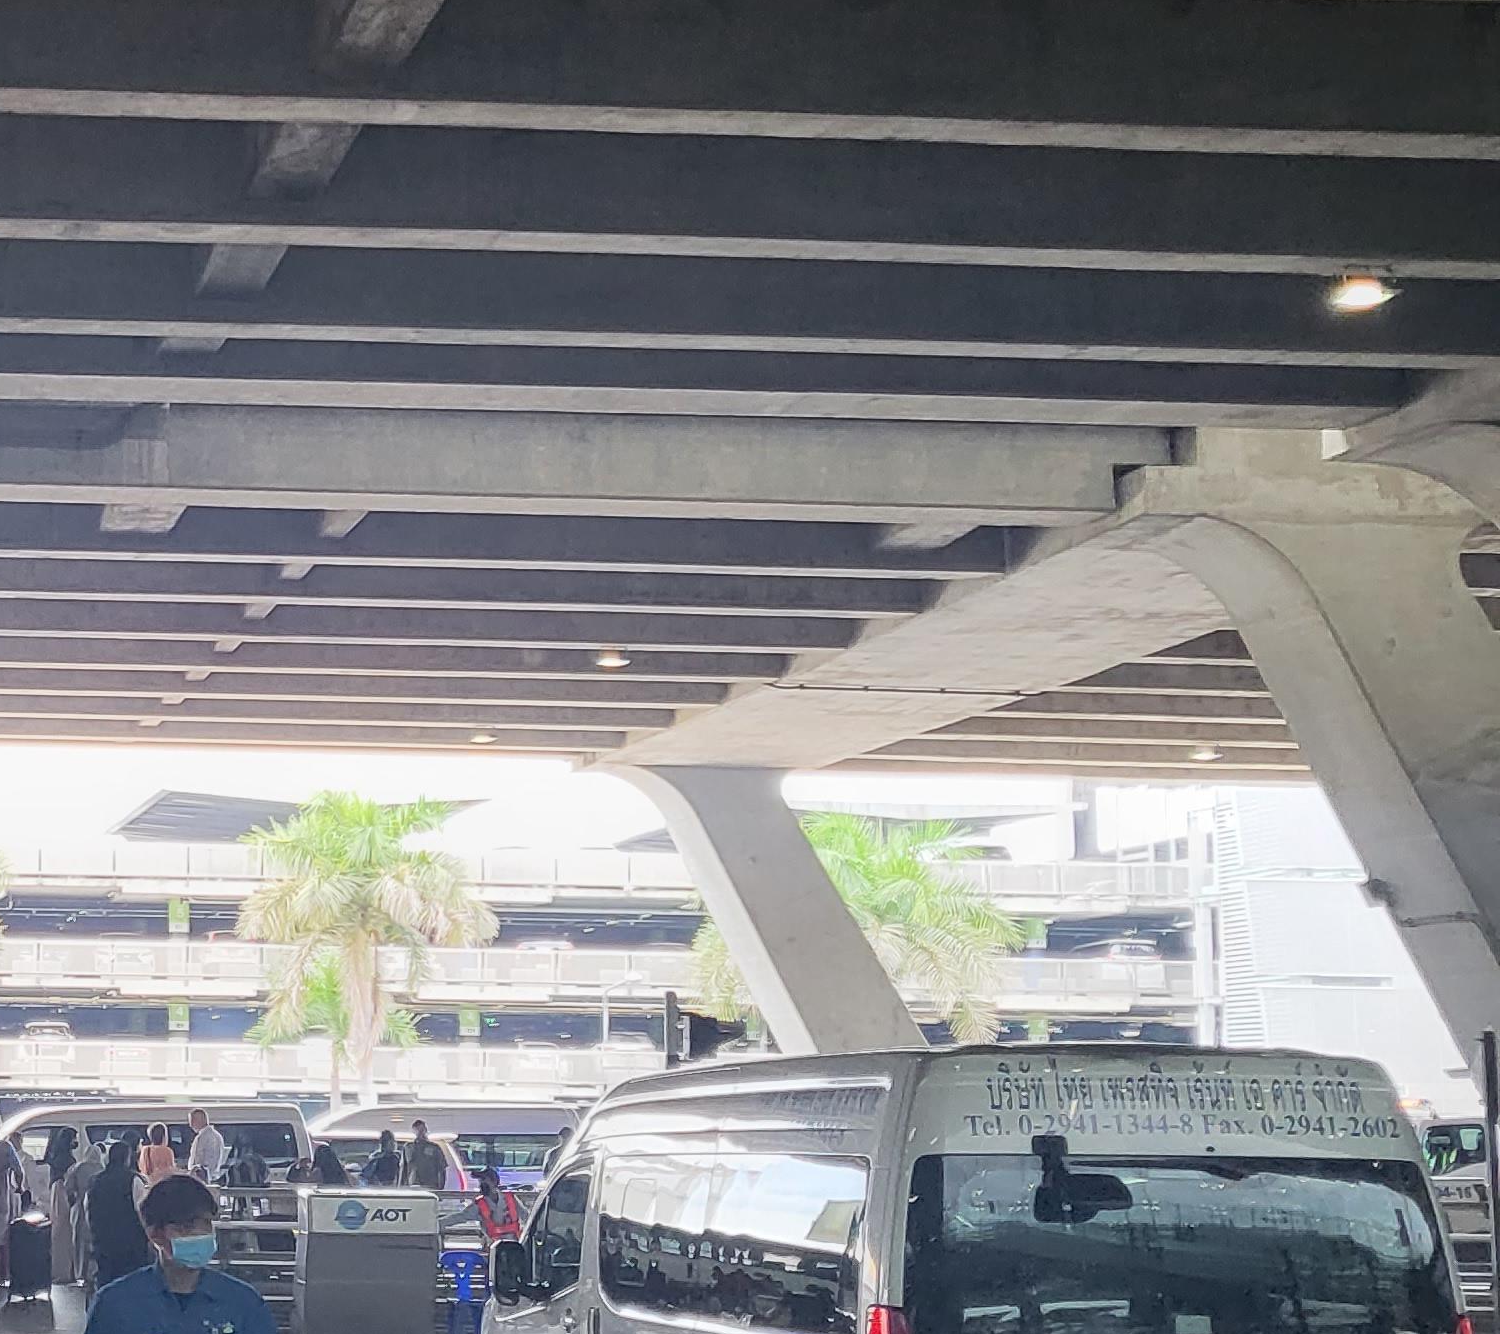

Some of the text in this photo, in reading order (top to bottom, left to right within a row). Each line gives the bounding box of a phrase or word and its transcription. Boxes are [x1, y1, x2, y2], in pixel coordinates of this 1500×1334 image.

[986, 1061, 1048, 1110] บริษัท
[1047, 1056, 1093, 1110] ไทย
[1313, 1063, 1364, 1114] จำกัด
[964, 1113, 1401, 1139] Tel. 0-2941-1344-8 Fax. 0-2941-2602
[370, 1208, 412, 1221] AOT
